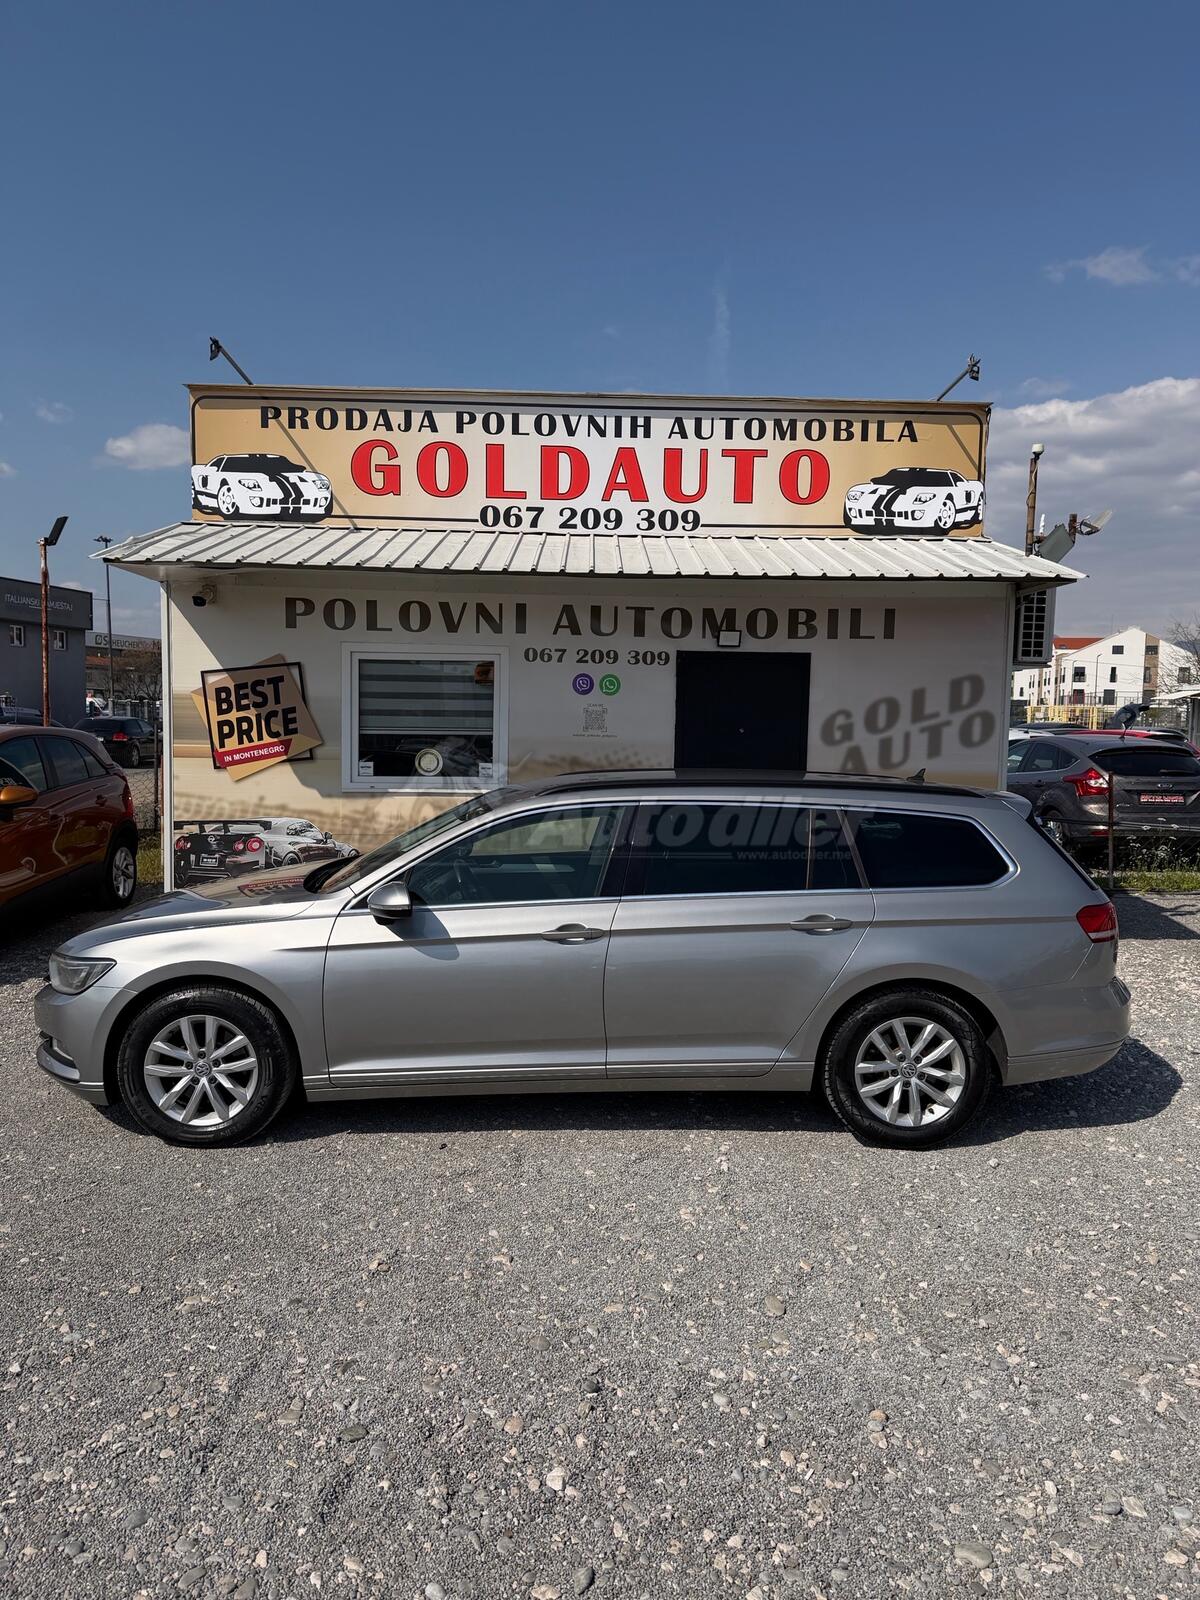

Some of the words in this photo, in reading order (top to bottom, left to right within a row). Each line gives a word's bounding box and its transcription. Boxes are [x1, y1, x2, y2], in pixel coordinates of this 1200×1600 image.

[261, 406, 439, 433] PRODAJA
[456, 411, 651, 439] POLOVNIH
[668, 416, 918, 443] AUTOMOBILA
[351, 439, 830, 505] GOLDAUTO
[480, 505, 544, 529] 067
[559, 506, 623, 530] 209
[637, 509, 702, 532] 309
[285, 597, 527, 634] POLOVNI
[553, 604, 896, 640] AUTOMOBILI
[524, 647, 567, 664] 067
[576, 649, 619, 665] 209
[627, 650, 670, 666] 309
[214, 675, 285, 717] BEST
[821, 674, 986, 747] GOLD
[217, 706, 298, 749] PRICE
[841, 710, 996, 773] AUTO
[223, 755, 232, 763] IN
[233, 745, 285, 760] MONTENEGRO
